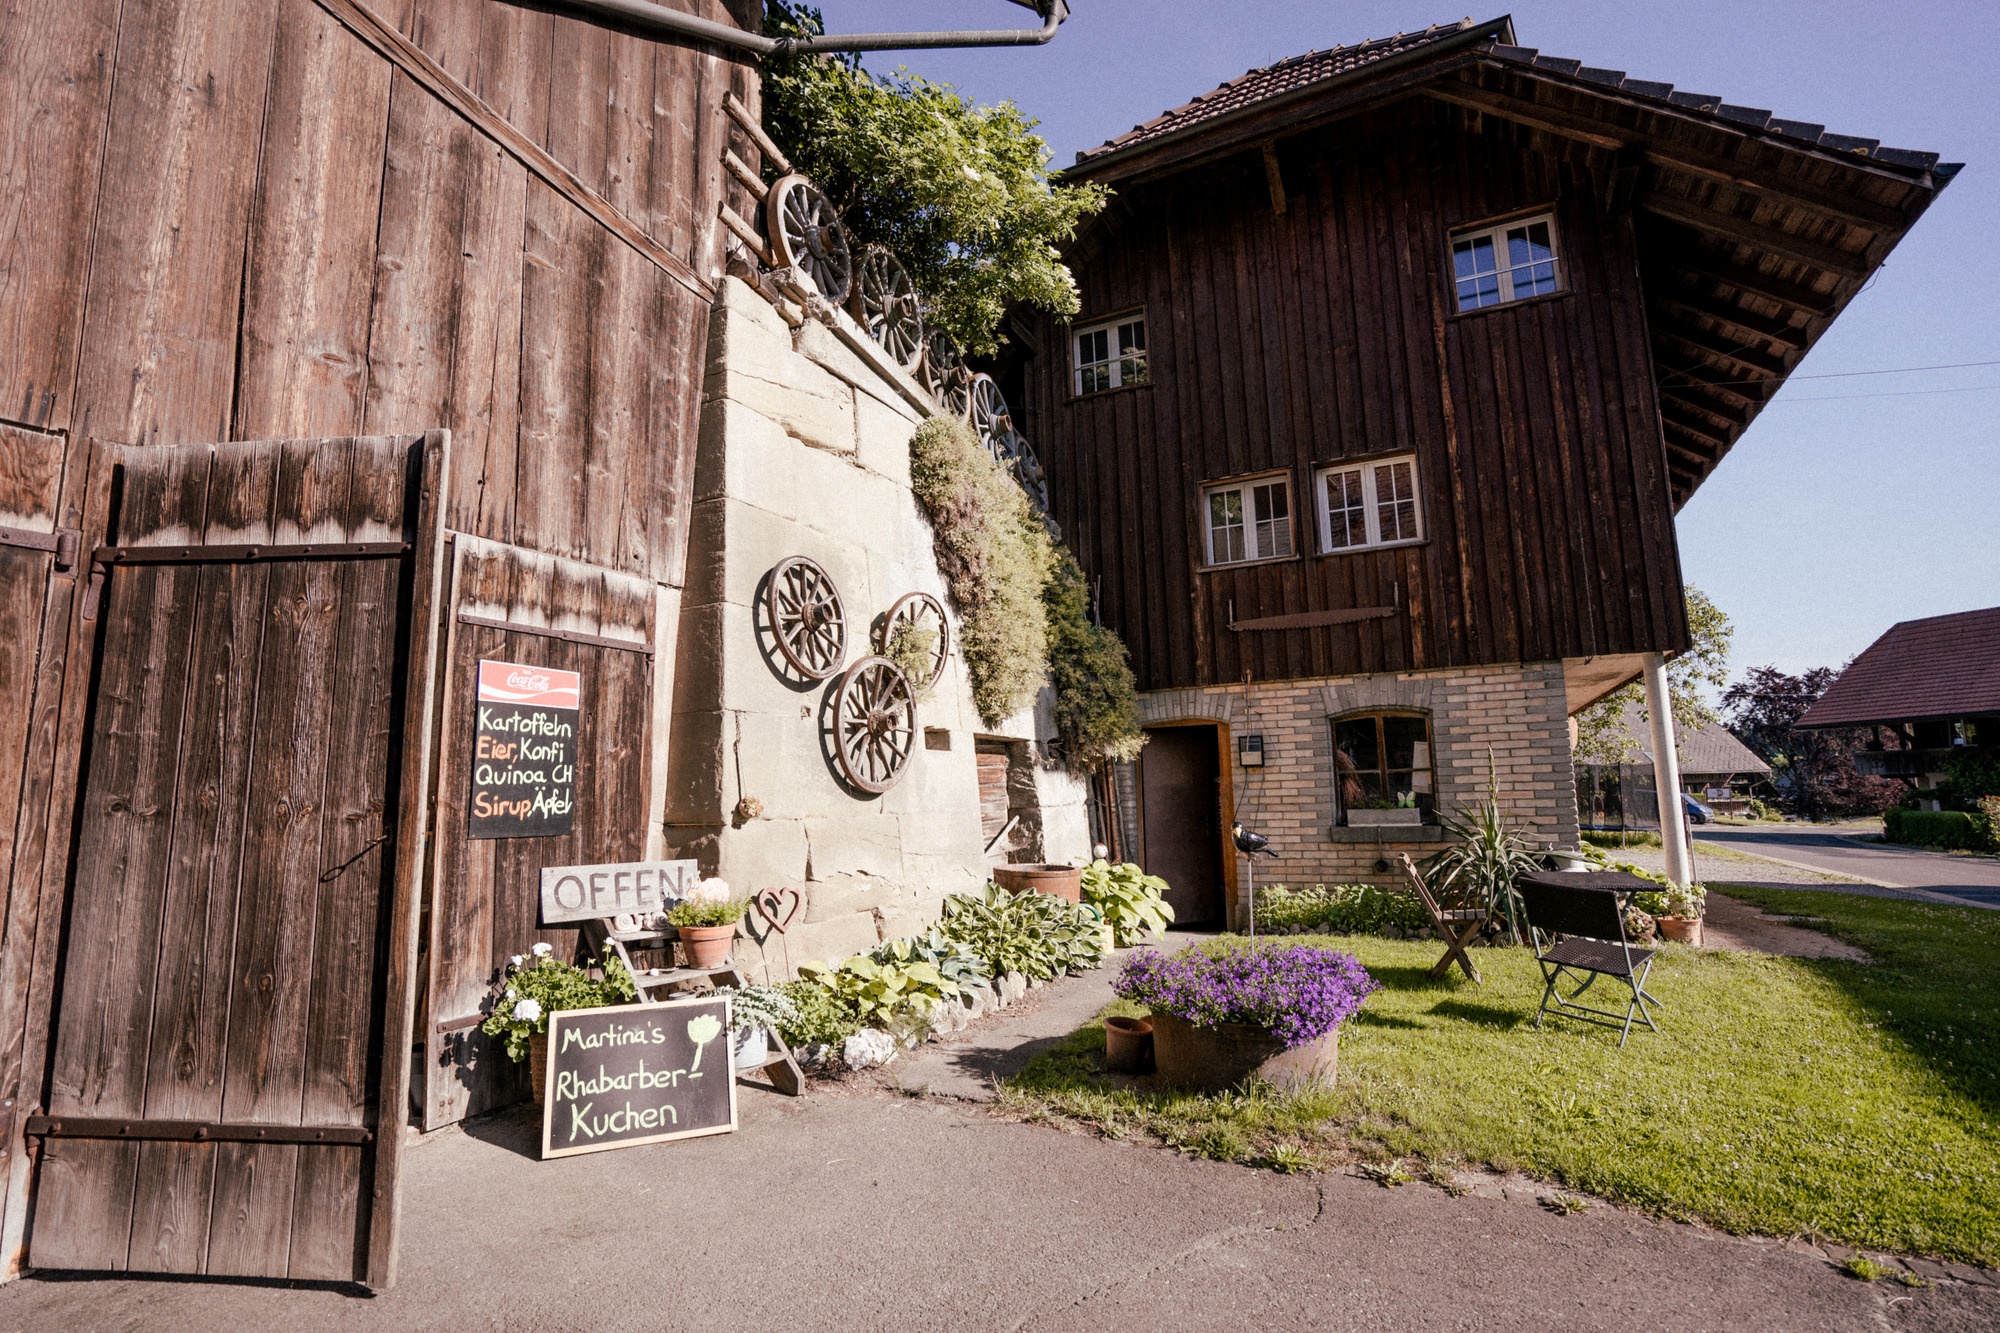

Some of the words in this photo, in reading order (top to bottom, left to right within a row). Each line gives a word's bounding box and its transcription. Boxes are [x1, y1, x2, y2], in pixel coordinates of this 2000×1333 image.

[479, 706, 572, 738] Kartoffeln
[477, 735, 518, 764] Eier,
[520, 736, 564, 763] Konfi
[475, 764, 547, 785] Quinoa
[552, 764, 573, 783] CH
[532, 786, 573, 819] Äpfel
[554, 866, 684, 910] OFFEN
[561, 1021, 666, 1054] Martina's
[569, 1101, 678, 1142] Kuchen
